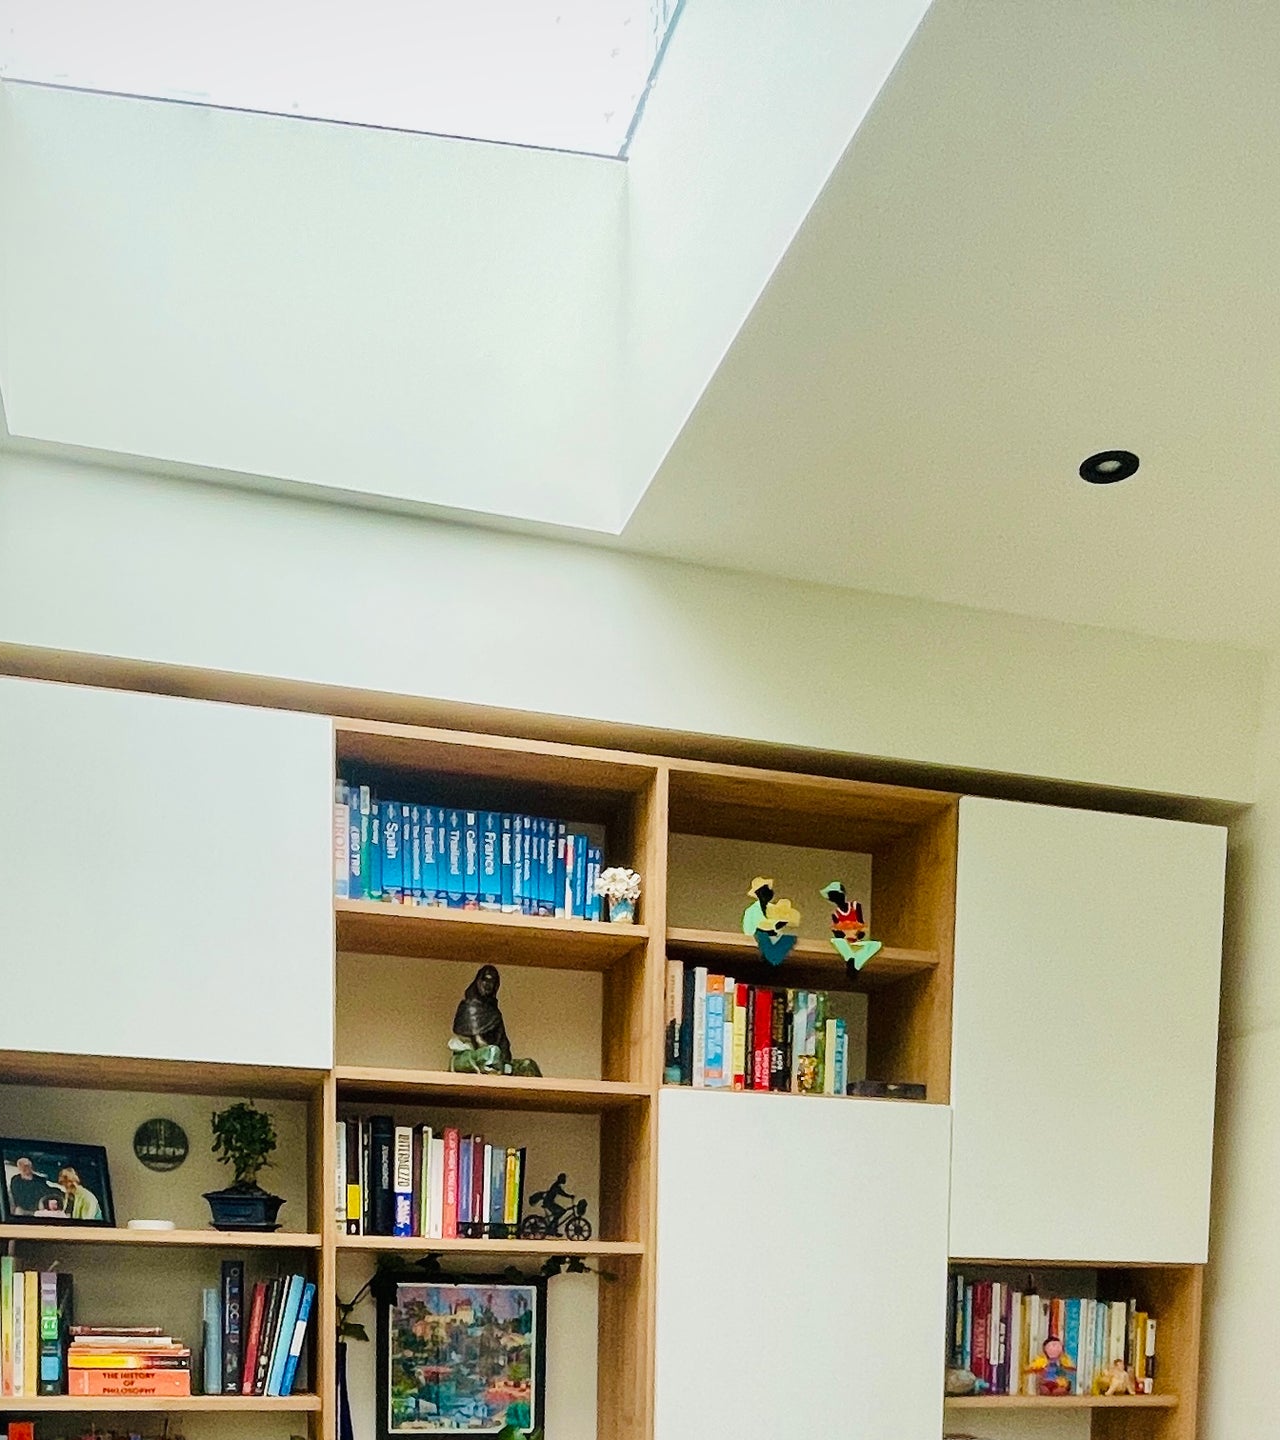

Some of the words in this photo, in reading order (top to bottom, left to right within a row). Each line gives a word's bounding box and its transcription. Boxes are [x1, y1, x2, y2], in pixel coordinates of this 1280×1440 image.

[384, 822, 399, 859] Spain
[424, 826, 435, 864] Ireland
[450, 830, 460, 875] Thailand
[466, 830, 476, 875] California
[484, 831, 497, 876] France
[397, 1133, 411, 1188] INTERMEZZO
[975, 1319, 985, 1359] FAMILY
